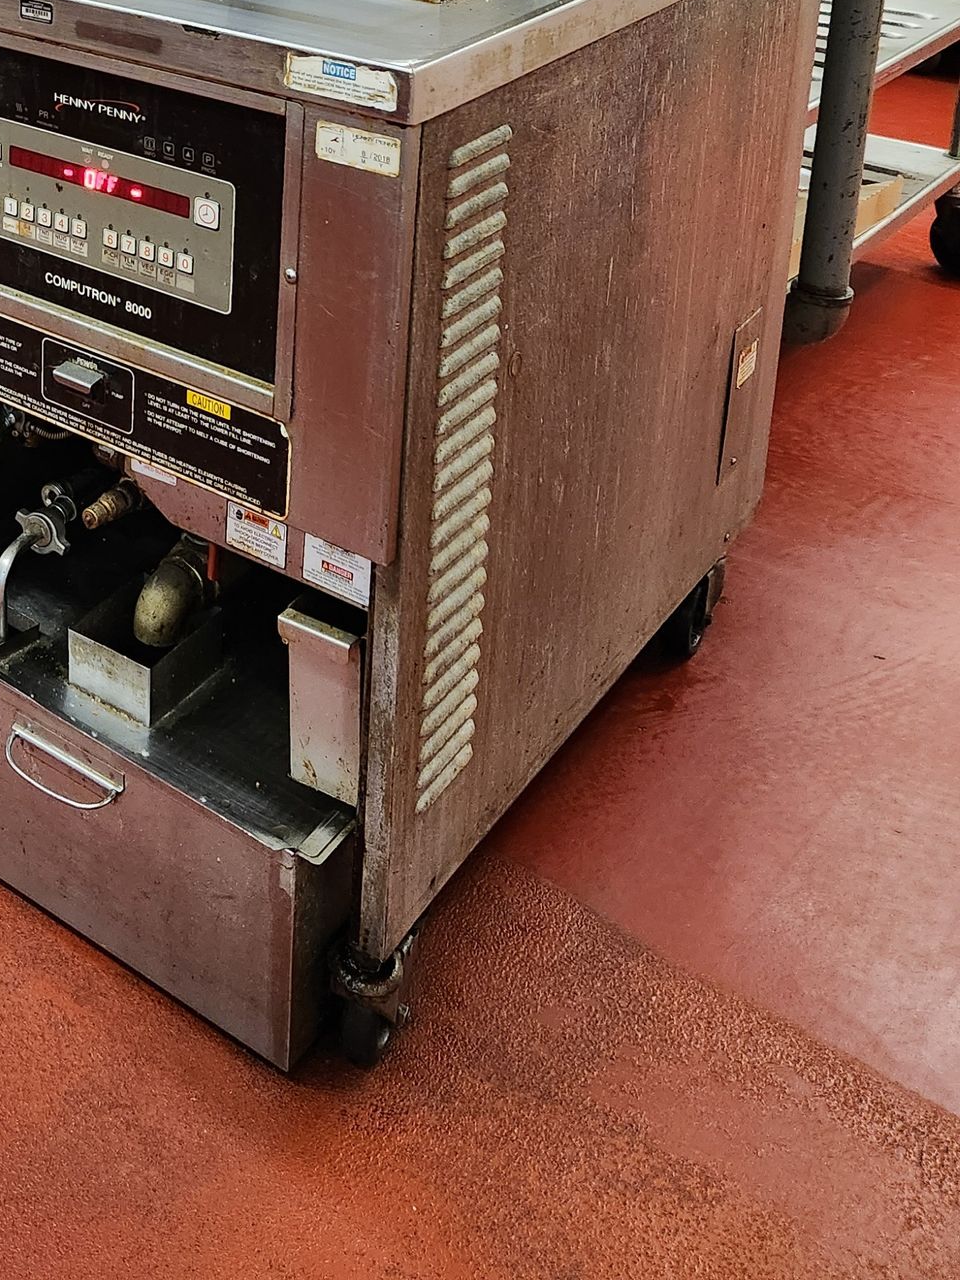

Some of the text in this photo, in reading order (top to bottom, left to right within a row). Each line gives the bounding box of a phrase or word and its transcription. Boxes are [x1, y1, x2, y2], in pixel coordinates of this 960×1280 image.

[323, 61, 356, 80] NOTICE
[54, 92, 141, 123] HENNY PENNY
[97, 151, 113, 160] READY
[84, 167, 118, 195] OFF
[9, 202, 188, 269] 1 2 3 4 5 6 7 8 9 0
[45, 272, 152, 320] COMPUTRON 8000
[192, 394, 224, 415] CAUTION
[167, 401, 179, 409] TURN
[200, 414, 214, 423] FRYER
[216, 420, 230, 429] UNTIL
[232, 426, 240, 434] THE
[242, 431, 275, 447] SHORTENING
[328, 564, 352, 581] DANGER
